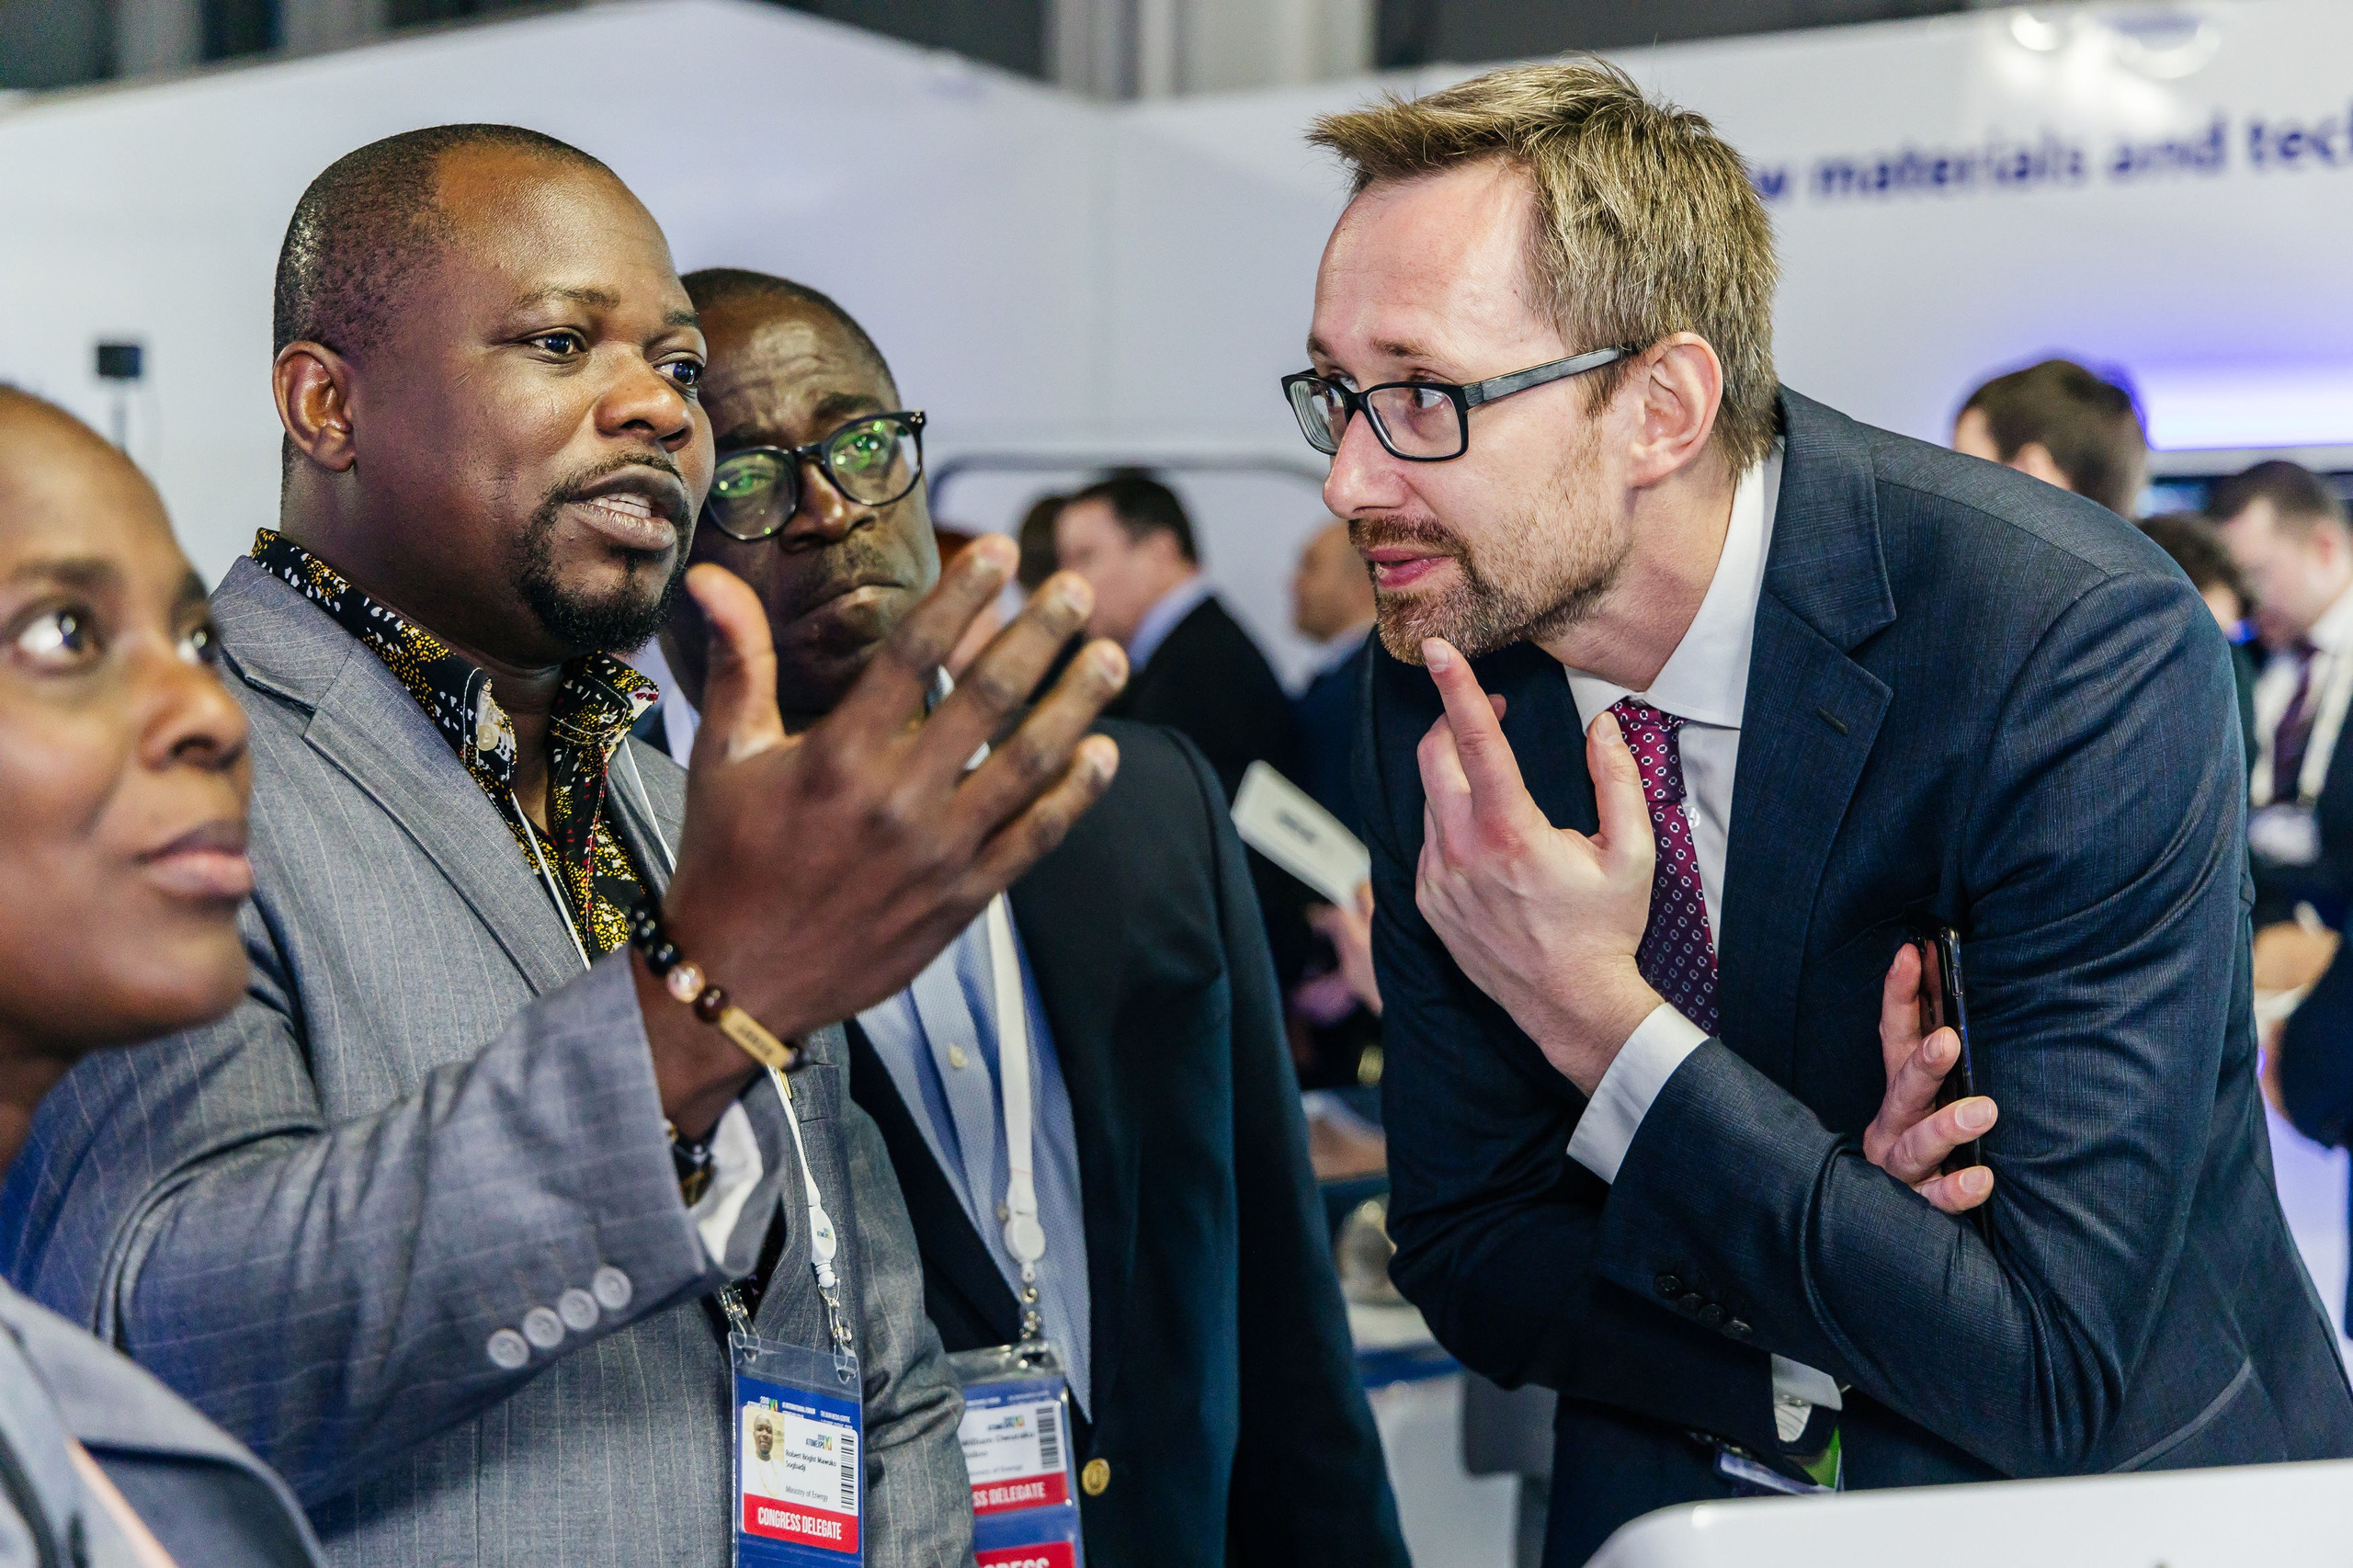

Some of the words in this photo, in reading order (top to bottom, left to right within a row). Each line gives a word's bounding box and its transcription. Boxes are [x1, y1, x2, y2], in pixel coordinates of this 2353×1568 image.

[1819, 129, 2085, 197] materials
[2114, 113, 2225, 178] and
[2248, 101, 2353, 171] tec
[801, 1452, 816, 1463] Bright
[785, 1485, 805, 1497] Ministry
[812, 1490, 829, 1502] Energy
[972, 1490, 988, 1507] SS
[988, 1482, 1046, 1506] DELEGATE
[757, 1506, 801, 1532] CONGRESS
[801, 1516, 842, 1540] DELEGATE
